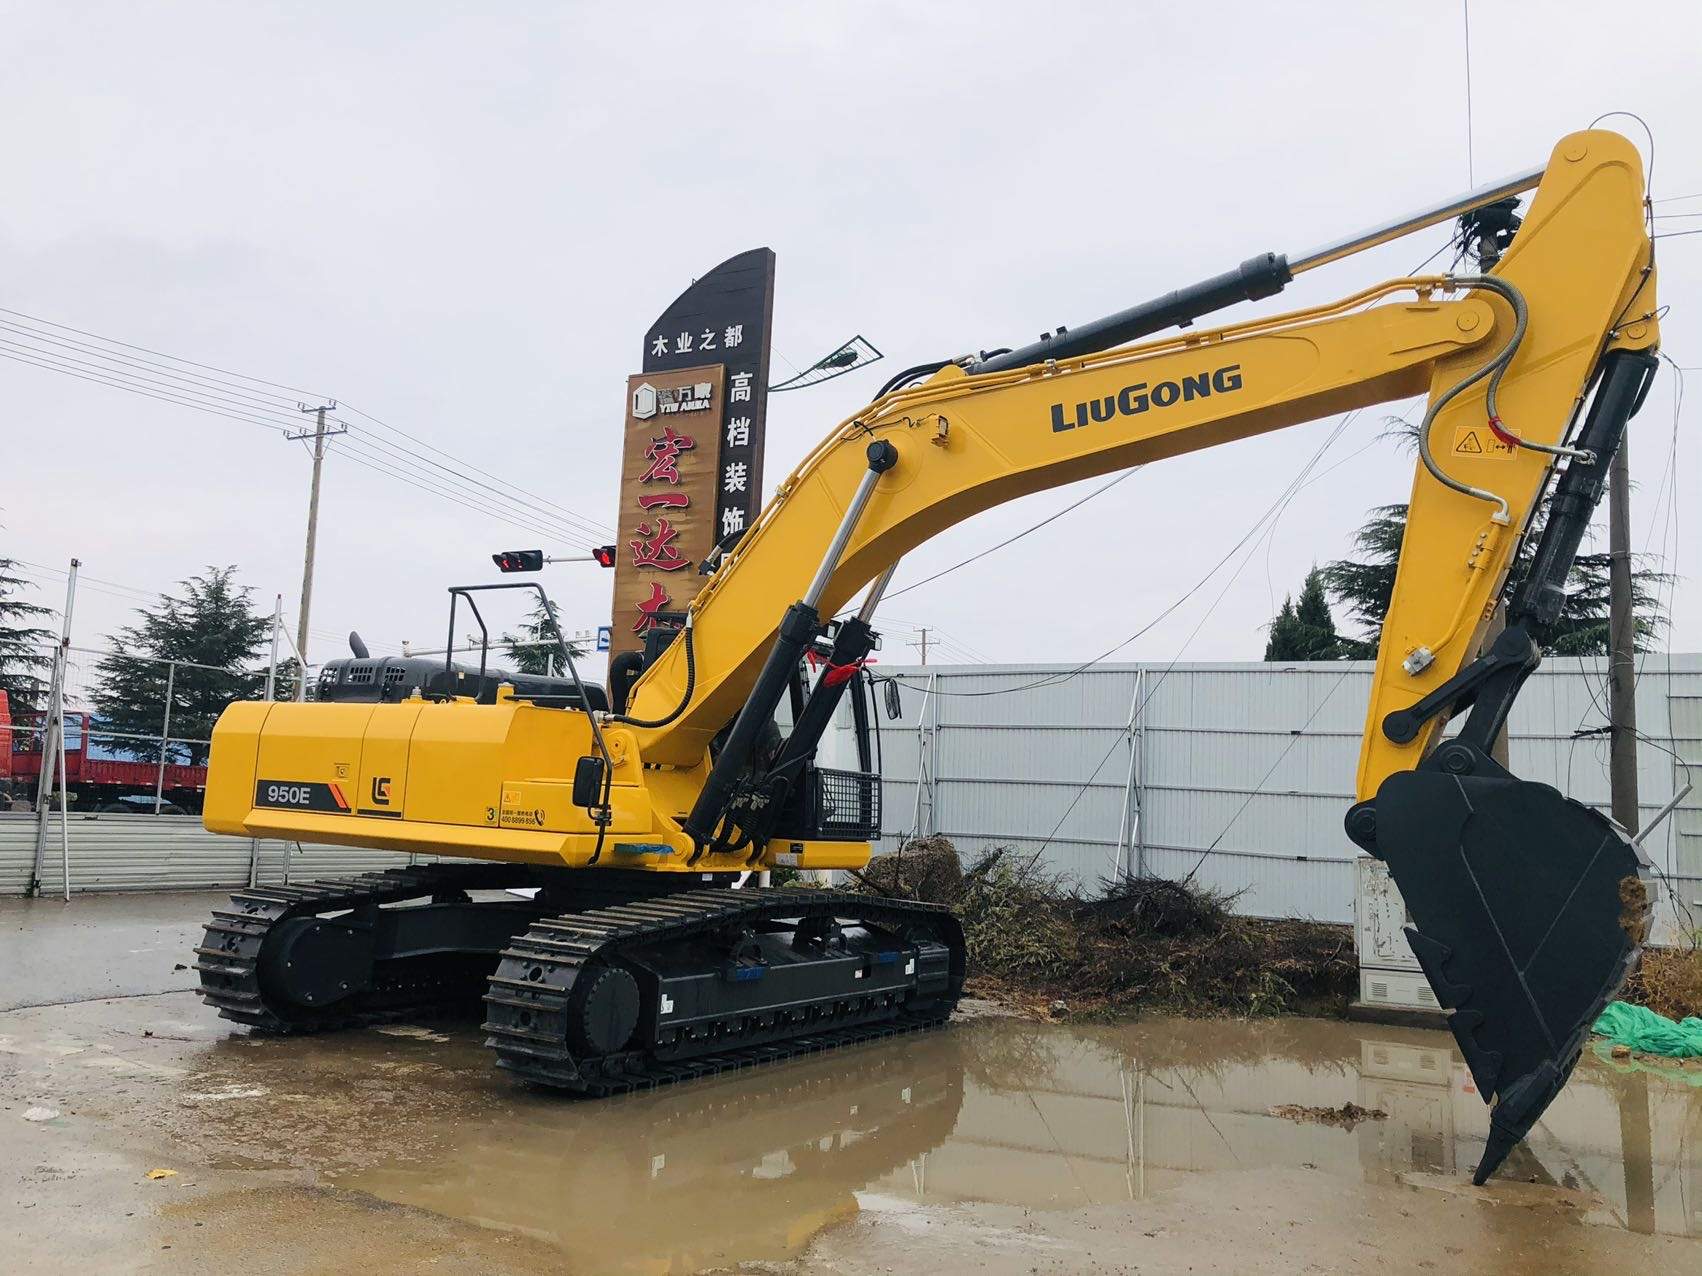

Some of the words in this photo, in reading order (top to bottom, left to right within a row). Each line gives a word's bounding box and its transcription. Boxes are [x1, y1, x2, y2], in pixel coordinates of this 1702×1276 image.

[651, 324, 744, 358] 木业之都
[1050, 364, 1243, 433] LIUGONG
[718, 371, 754, 572] 高档装饰
[267, 785, 312, 804] 950E
[486, 807, 495, 821] 3
